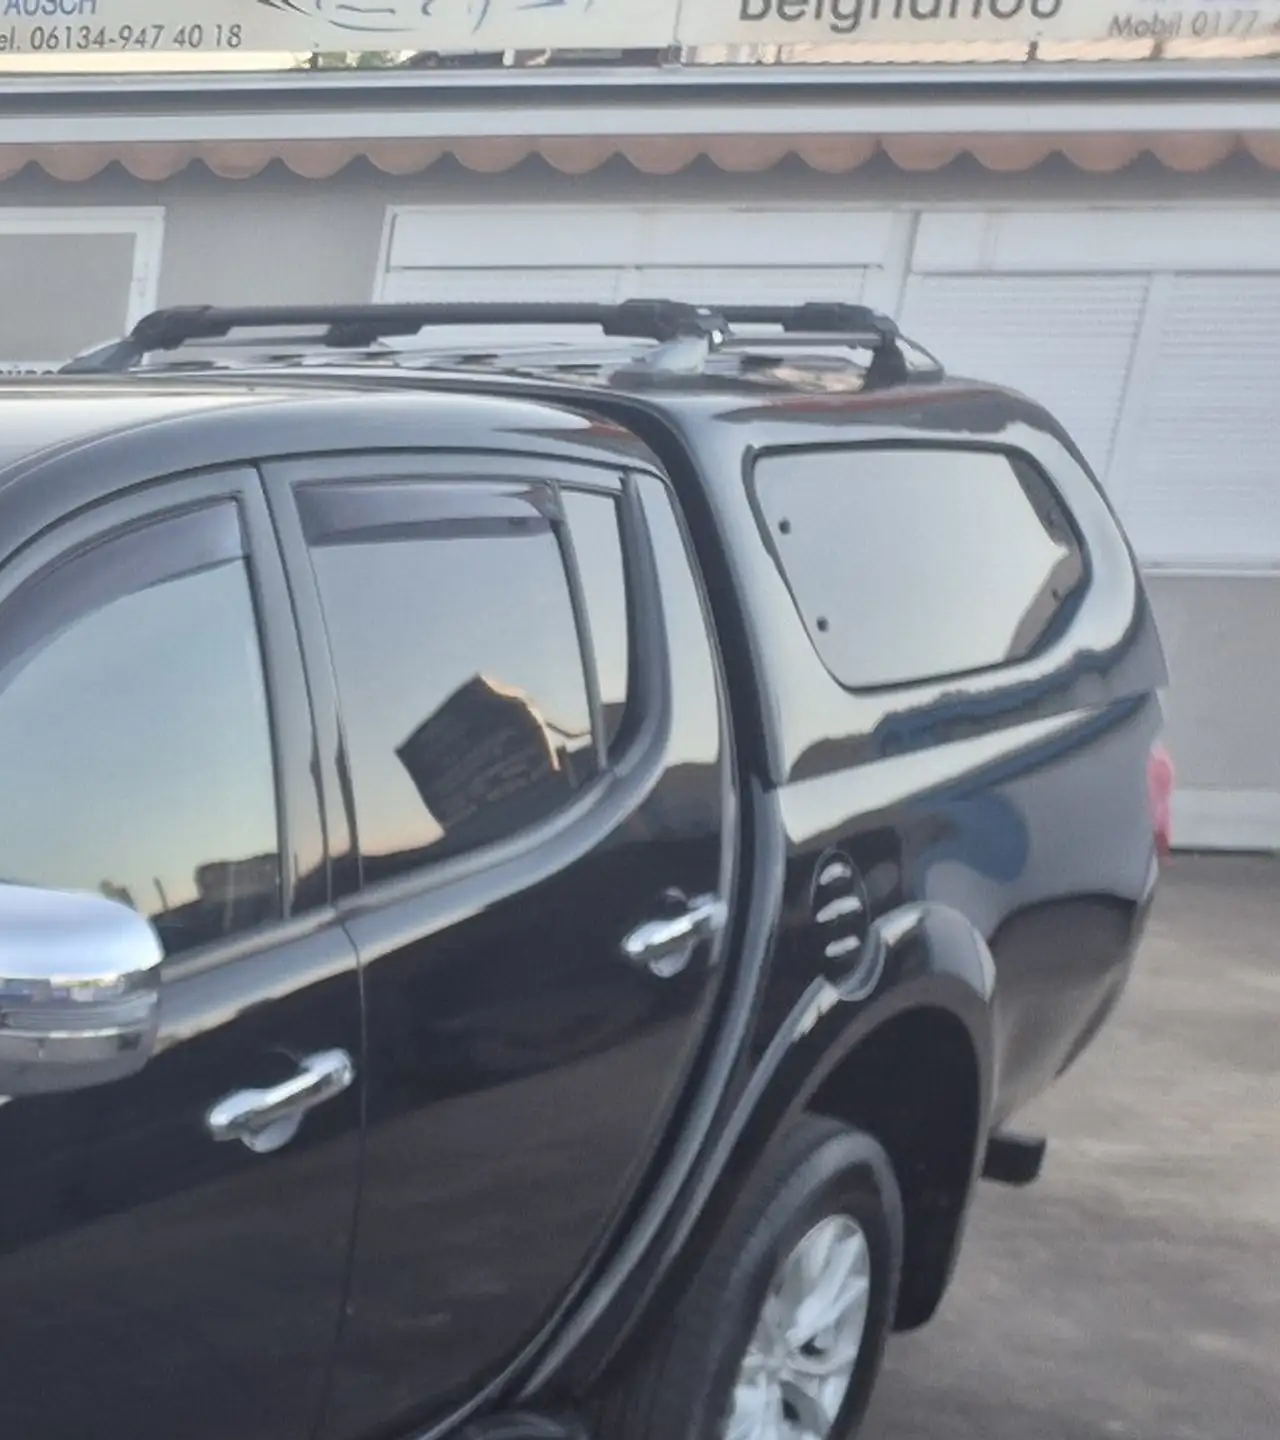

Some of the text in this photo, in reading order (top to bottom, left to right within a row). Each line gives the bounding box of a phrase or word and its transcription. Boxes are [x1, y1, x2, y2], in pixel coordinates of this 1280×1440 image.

[29, 24, 165, 51] 06134-947
[172, 24, 204, 49] 40
[215, 24, 242, 49] 18
